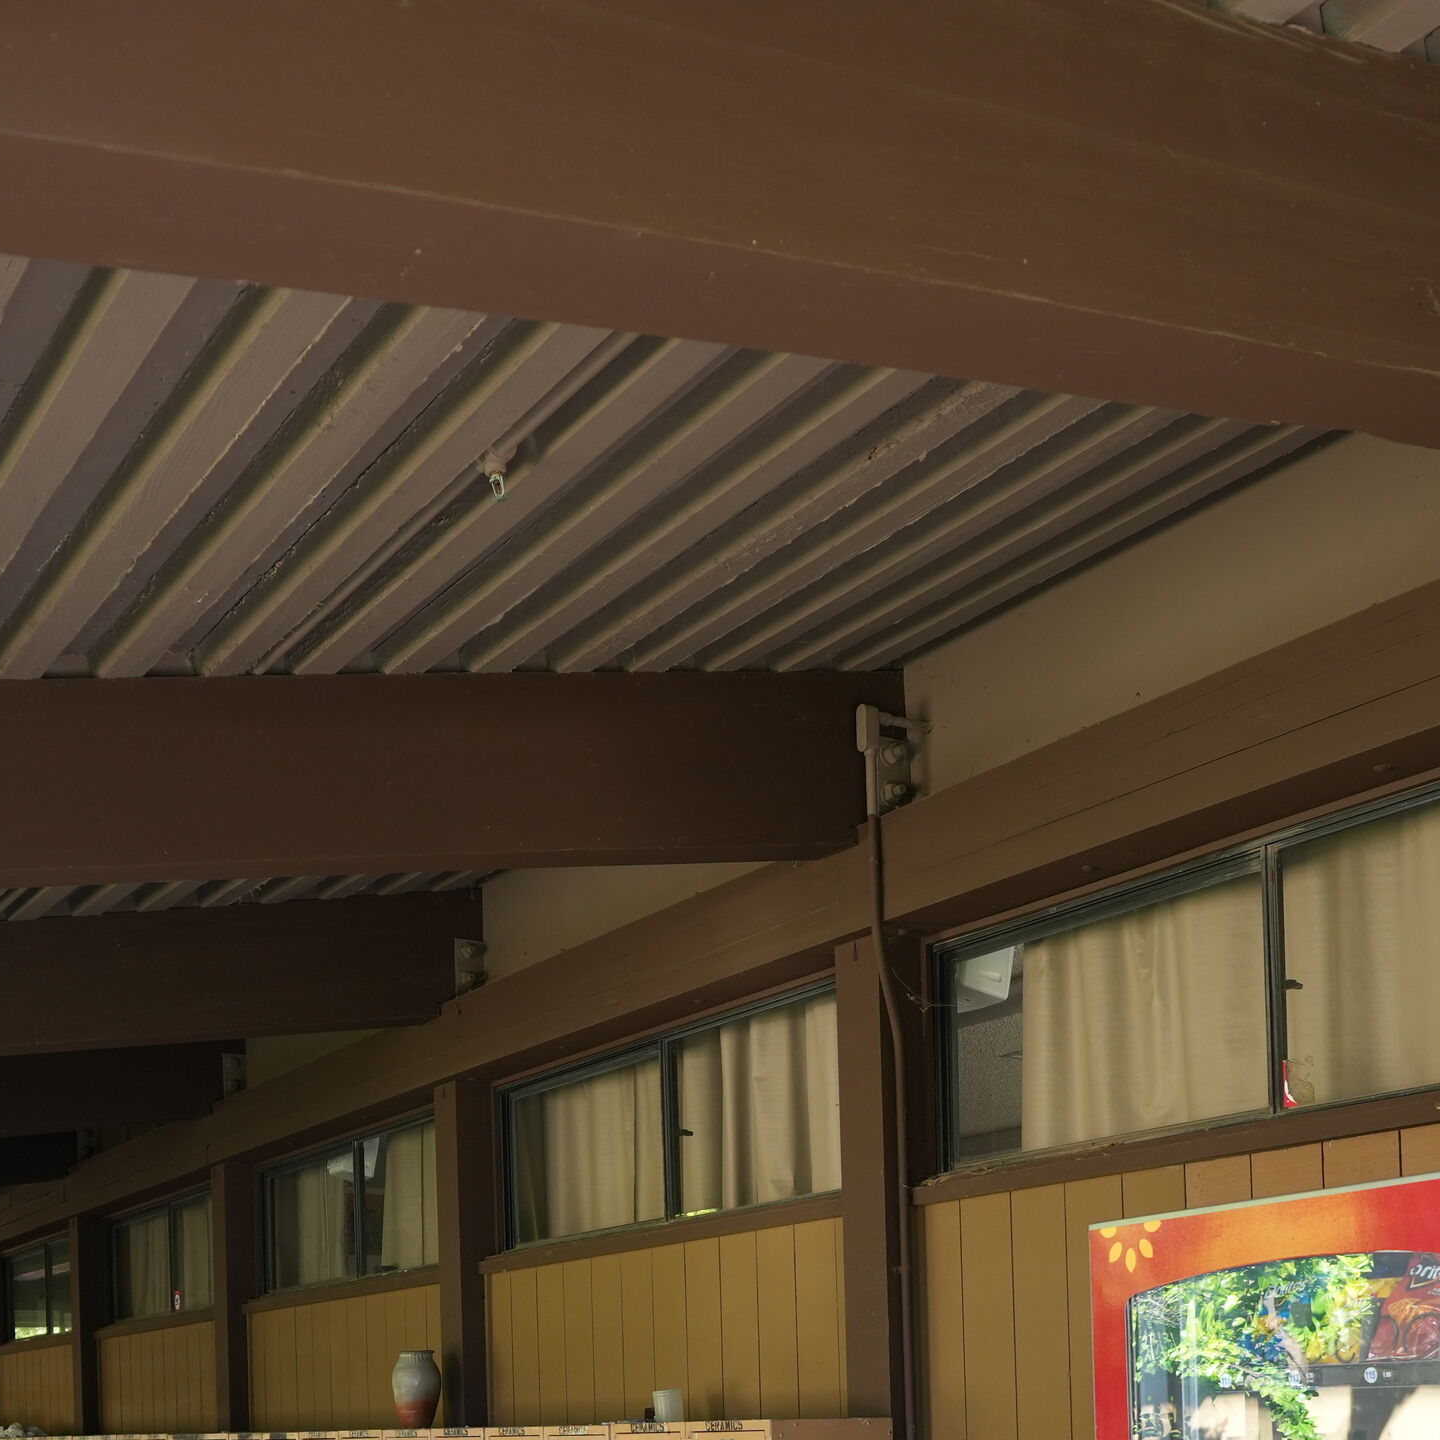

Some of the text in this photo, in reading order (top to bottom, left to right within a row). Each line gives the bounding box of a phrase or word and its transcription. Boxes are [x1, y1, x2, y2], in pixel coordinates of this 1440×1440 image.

[1364, 1370, 1377, 1380] 115
[630, 1423, 665, 1432] CERAMICS
[706, 1421, 743, 1431] CERAMICS
